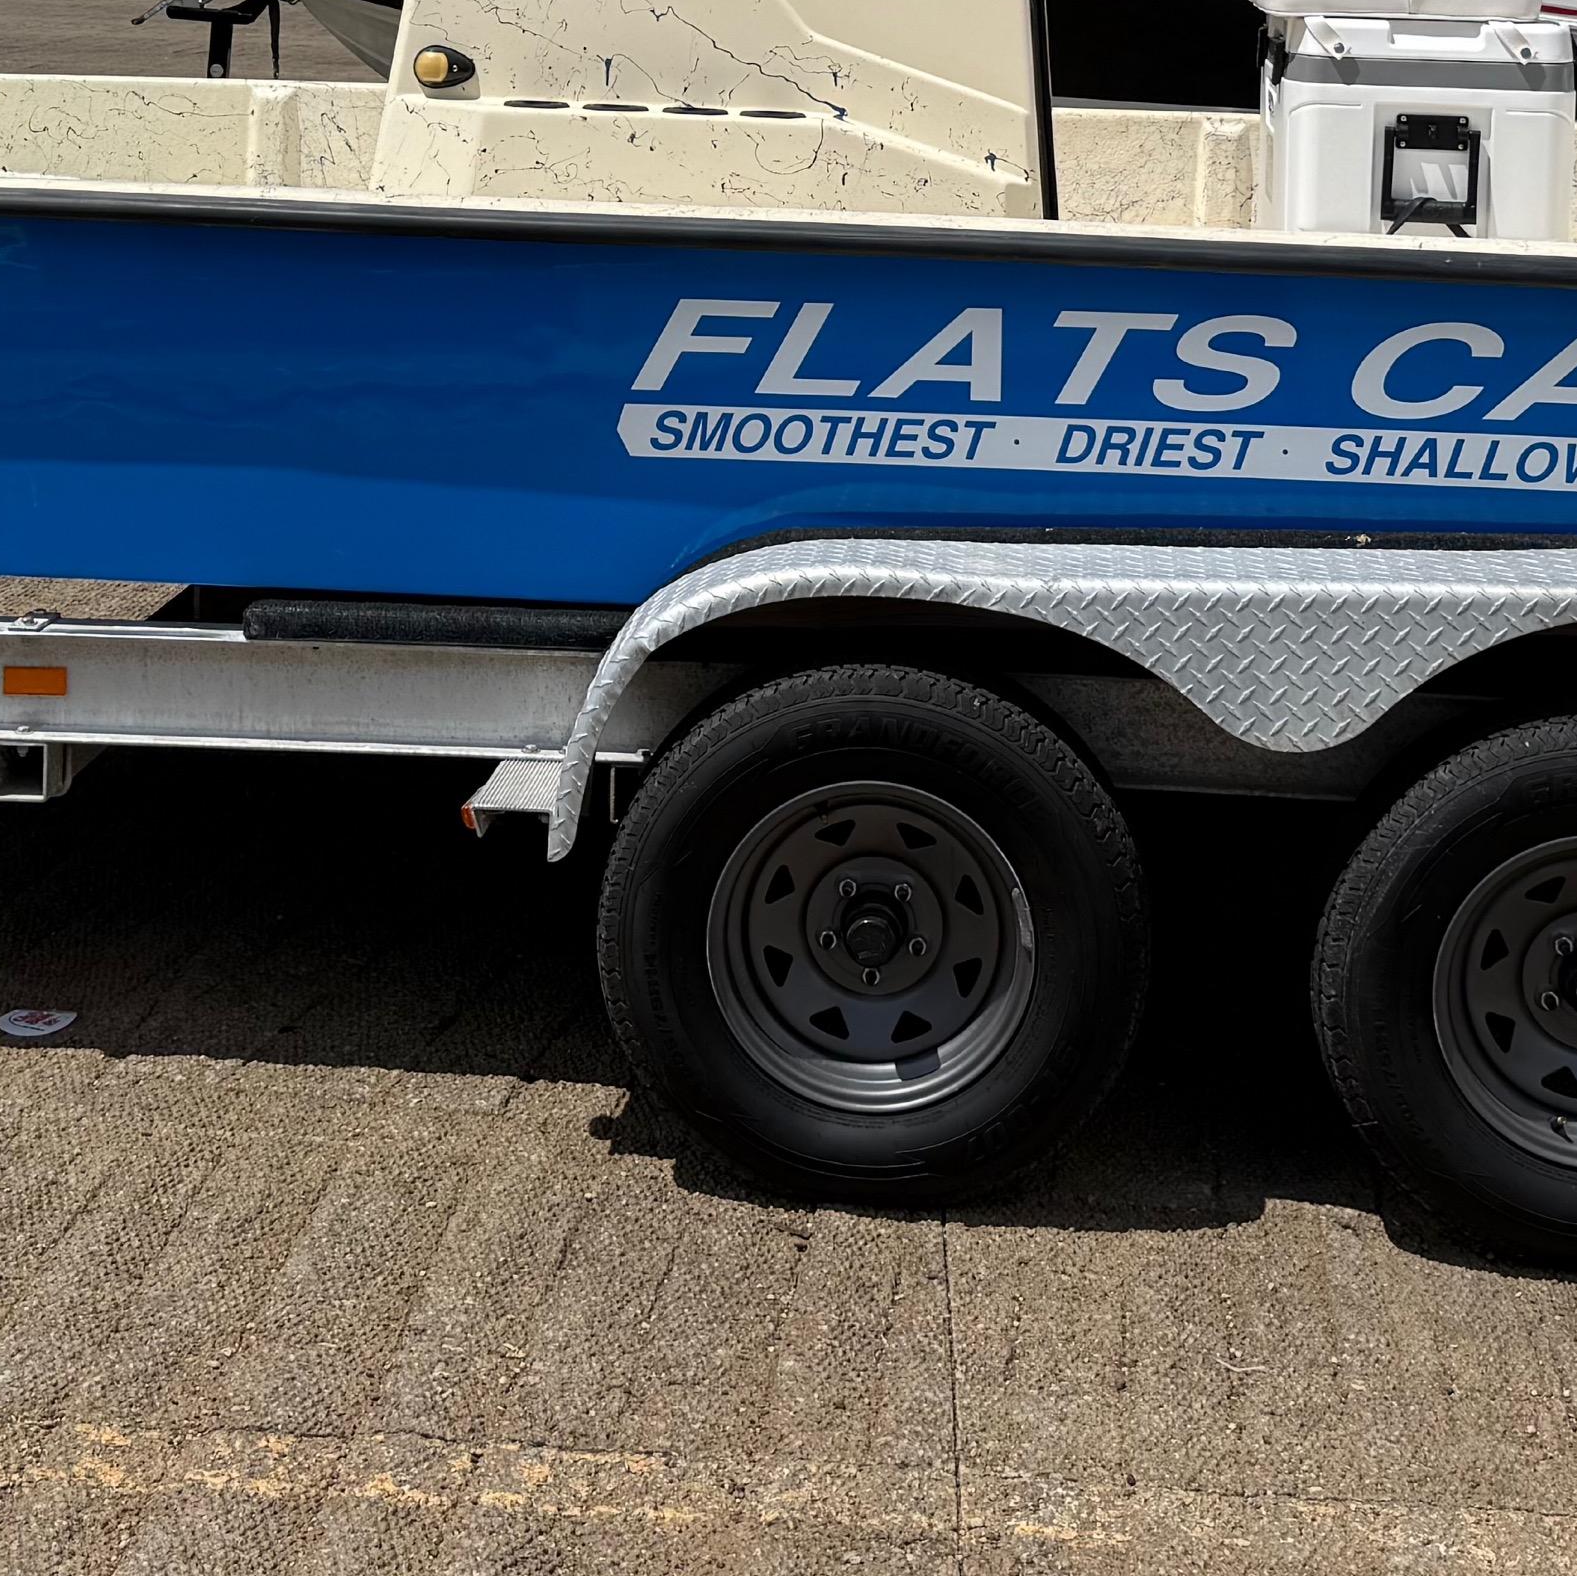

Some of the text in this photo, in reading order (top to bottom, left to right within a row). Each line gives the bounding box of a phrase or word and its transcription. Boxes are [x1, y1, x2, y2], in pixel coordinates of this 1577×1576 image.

[631, 298, 1298, 412] FLATS
[649, 409, 997, 461] SMOOTHEST
[1055, 423, 1265, 472] DRIEST
